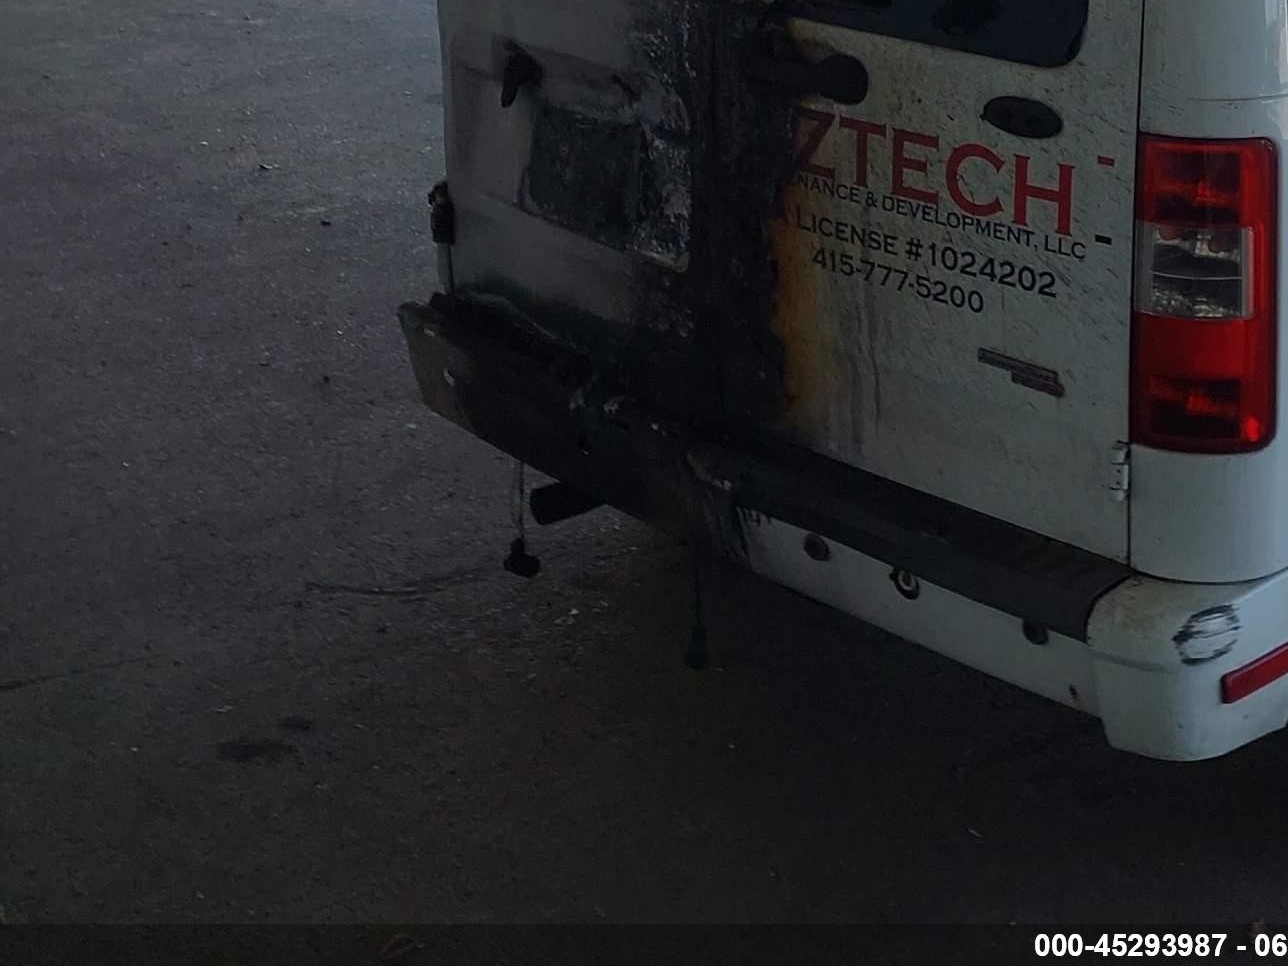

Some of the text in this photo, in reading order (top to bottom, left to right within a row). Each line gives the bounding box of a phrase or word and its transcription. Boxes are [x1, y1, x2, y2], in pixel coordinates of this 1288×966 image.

[796, 207, 898, 256] LICENSE
[865, 190, 878, 209] &
[882, 194, 1038, 252] DEVELOPMENT,
[1043, 234, 1086, 260] LLC
[812, 247, 985, 314] 415-777-5200
